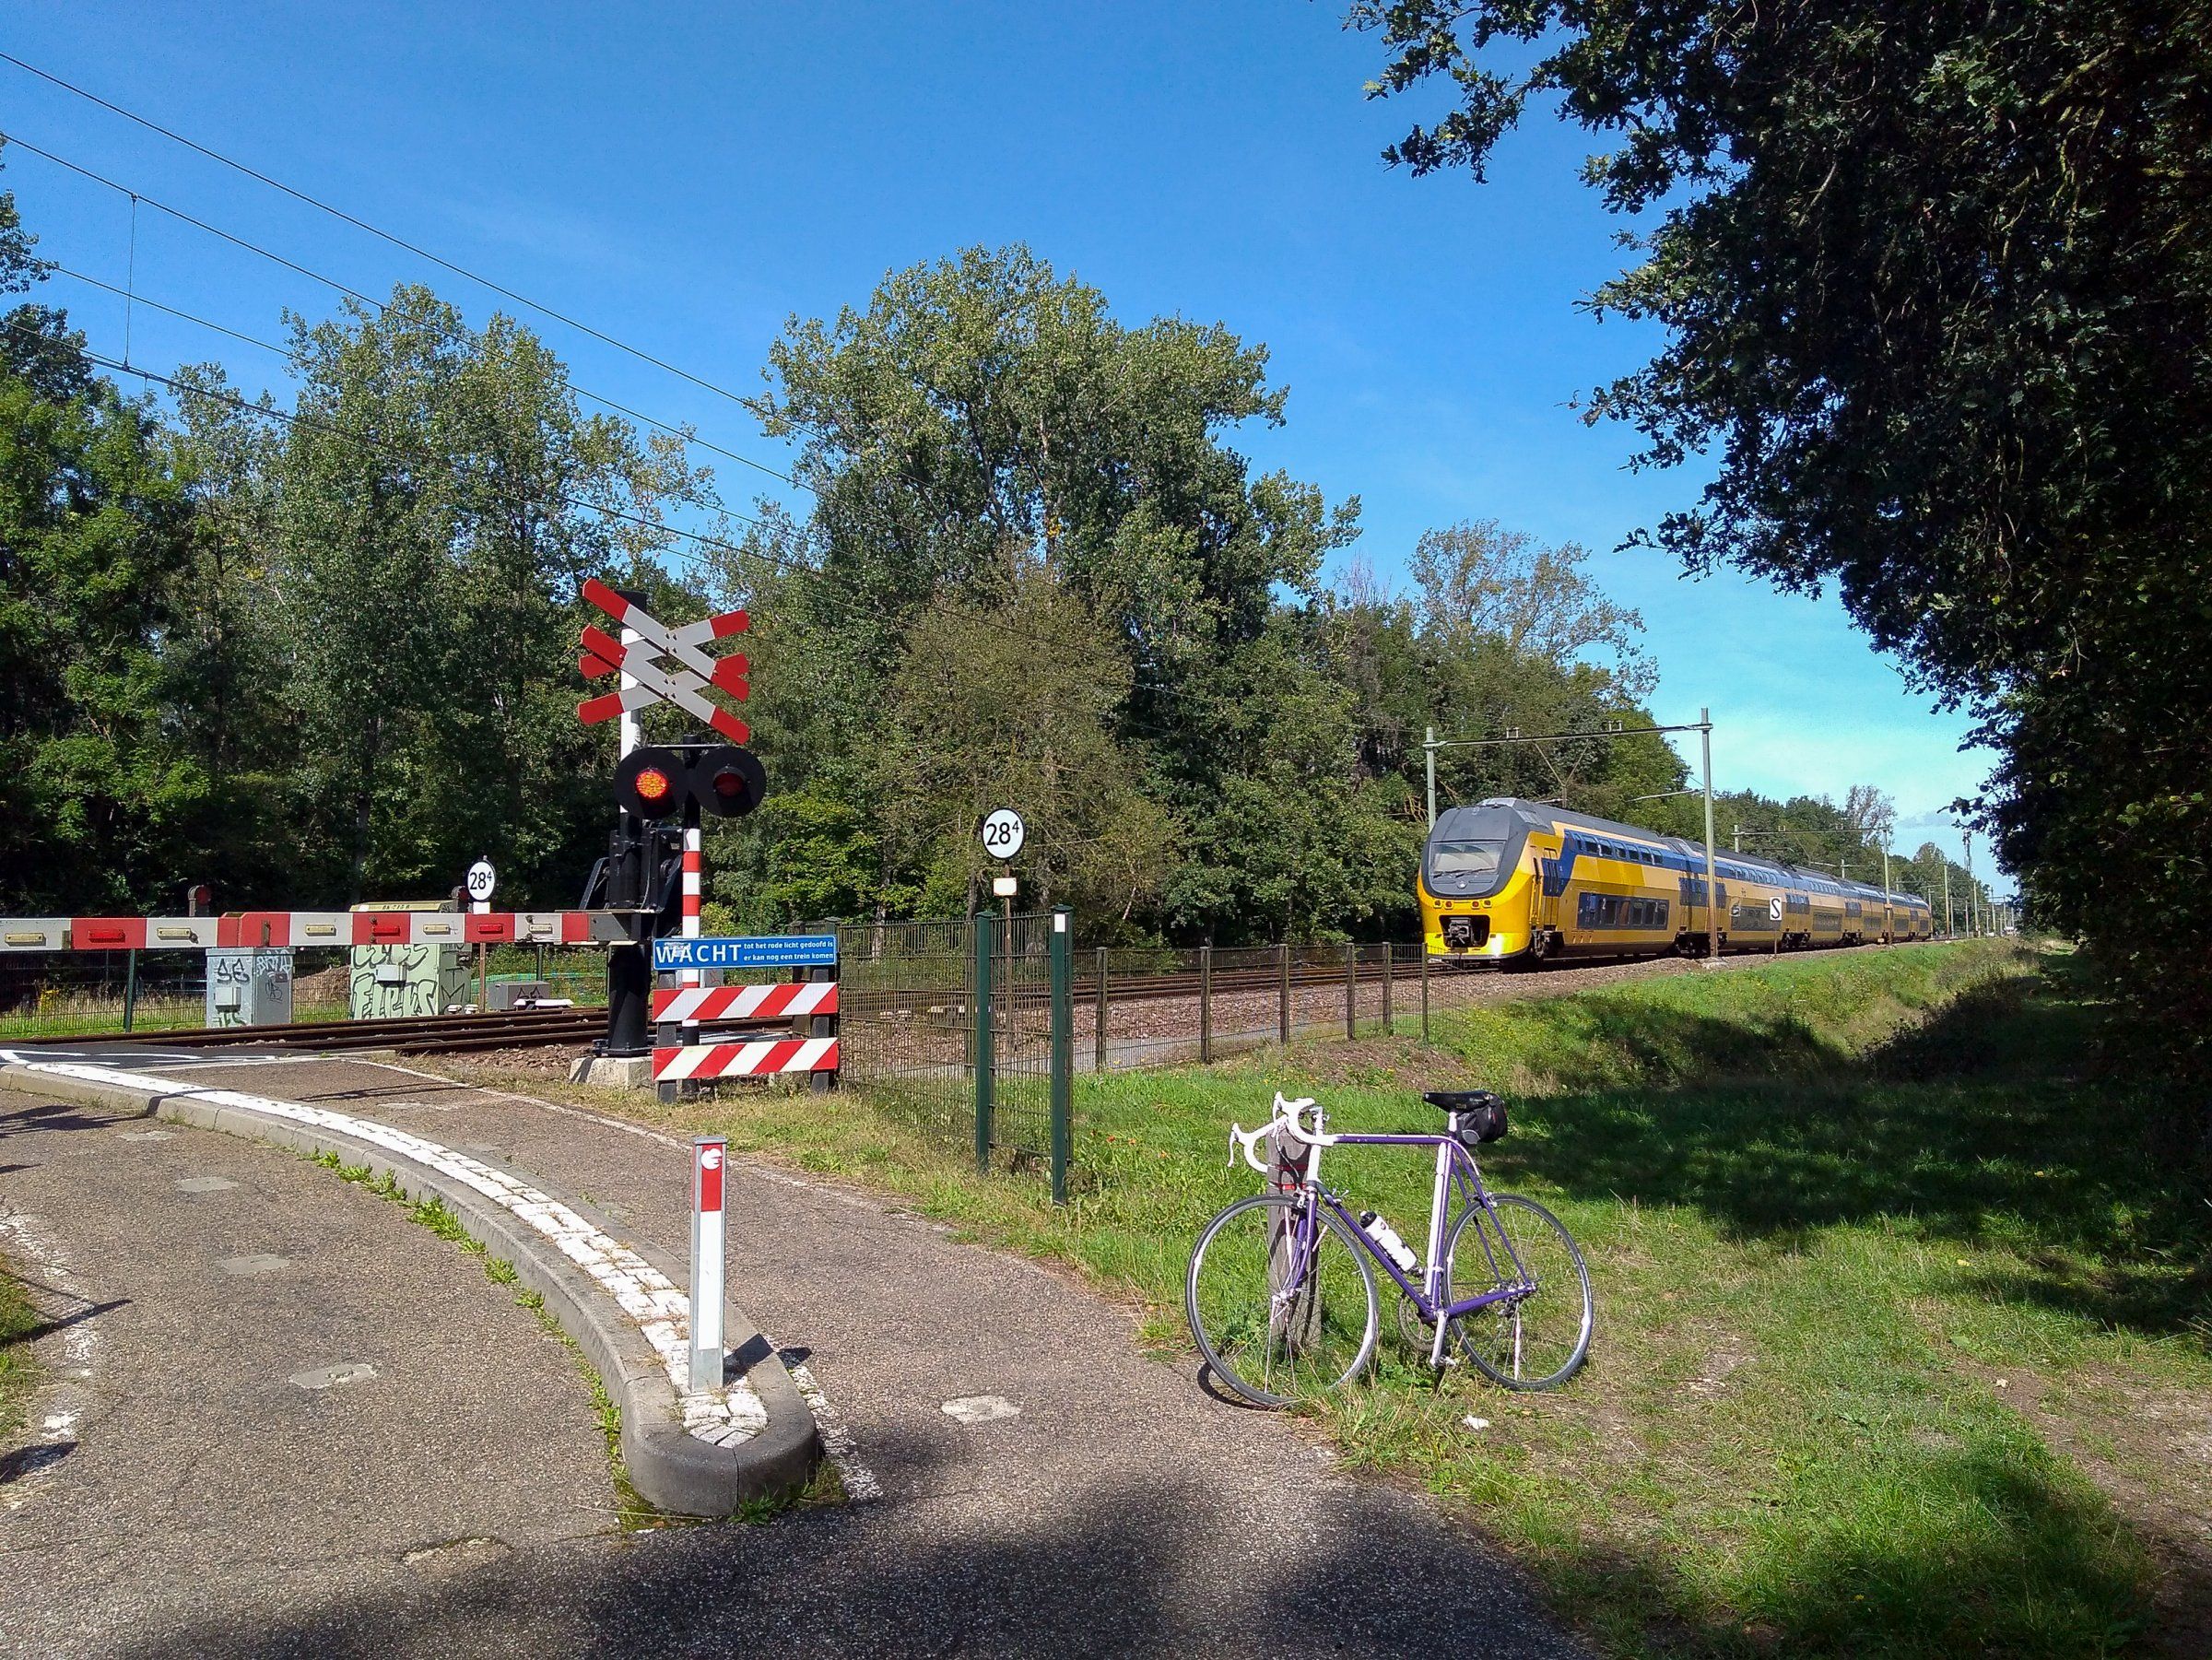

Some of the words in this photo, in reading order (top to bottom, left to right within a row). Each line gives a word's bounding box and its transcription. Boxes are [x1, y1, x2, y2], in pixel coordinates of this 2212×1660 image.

[1771, 898, 1781, 919] S
[655, 944, 742, 963] WACHT
[800, 941, 826, 949] gedoofd
